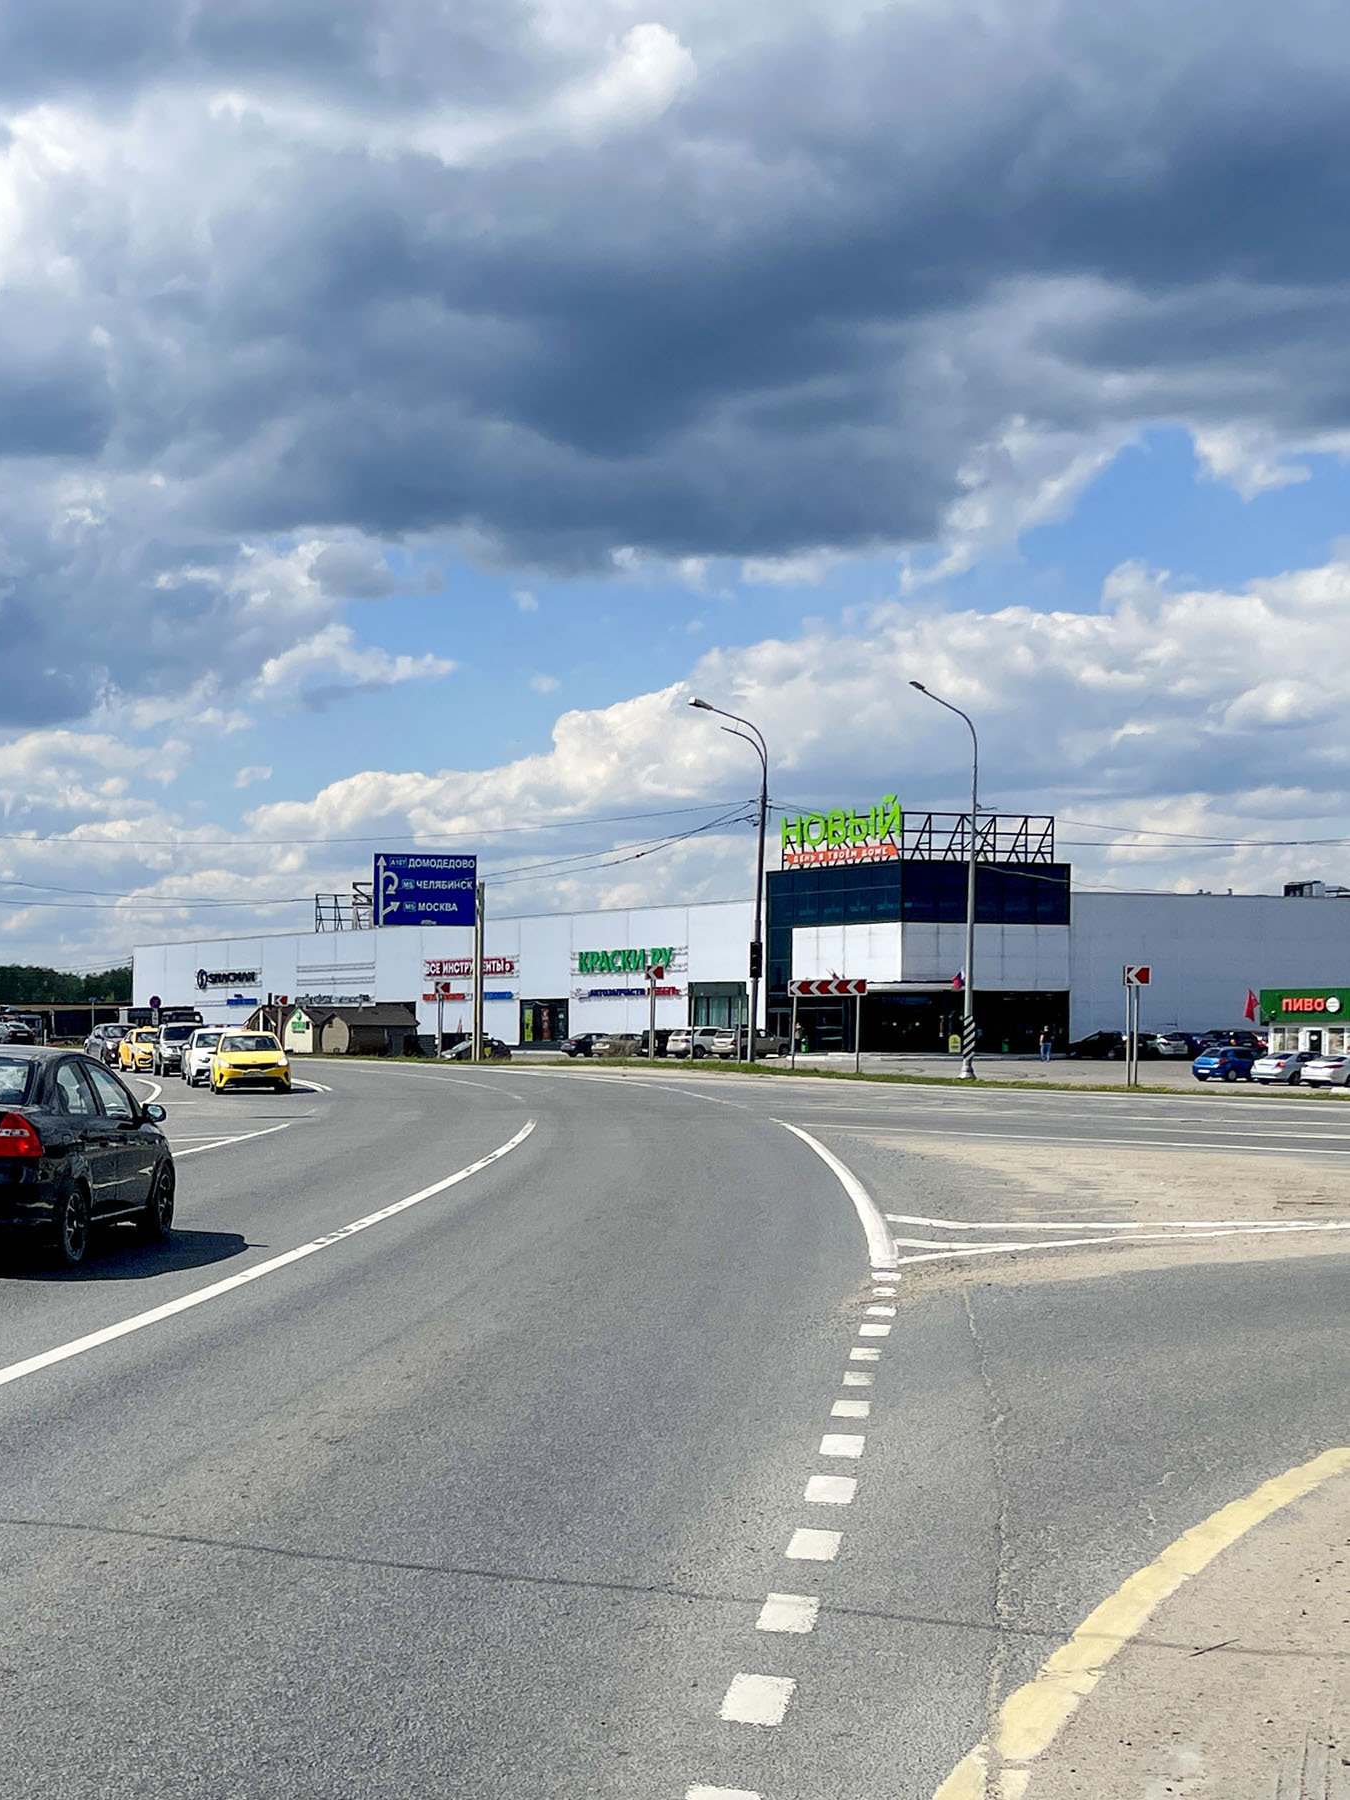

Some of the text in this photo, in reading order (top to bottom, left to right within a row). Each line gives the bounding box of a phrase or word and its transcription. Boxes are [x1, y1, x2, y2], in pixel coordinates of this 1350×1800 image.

[781, 795, 901, 849] НОВЫЙ
[862, 847, 888, 857] ДОМЕ
[408, 858, 475, 870] ДОМОДЕДОВО
[416, 880, 473, 890] ЧЕЛЯБИНСК
[418, 903, 458, 912] МОСКВА
[442, 960, 504, 974] ИНСТРУЕНТЫ
[578, 949, 645, 973] КРАСКИ
[1282, 998, 1325, 1011] ПИВО
